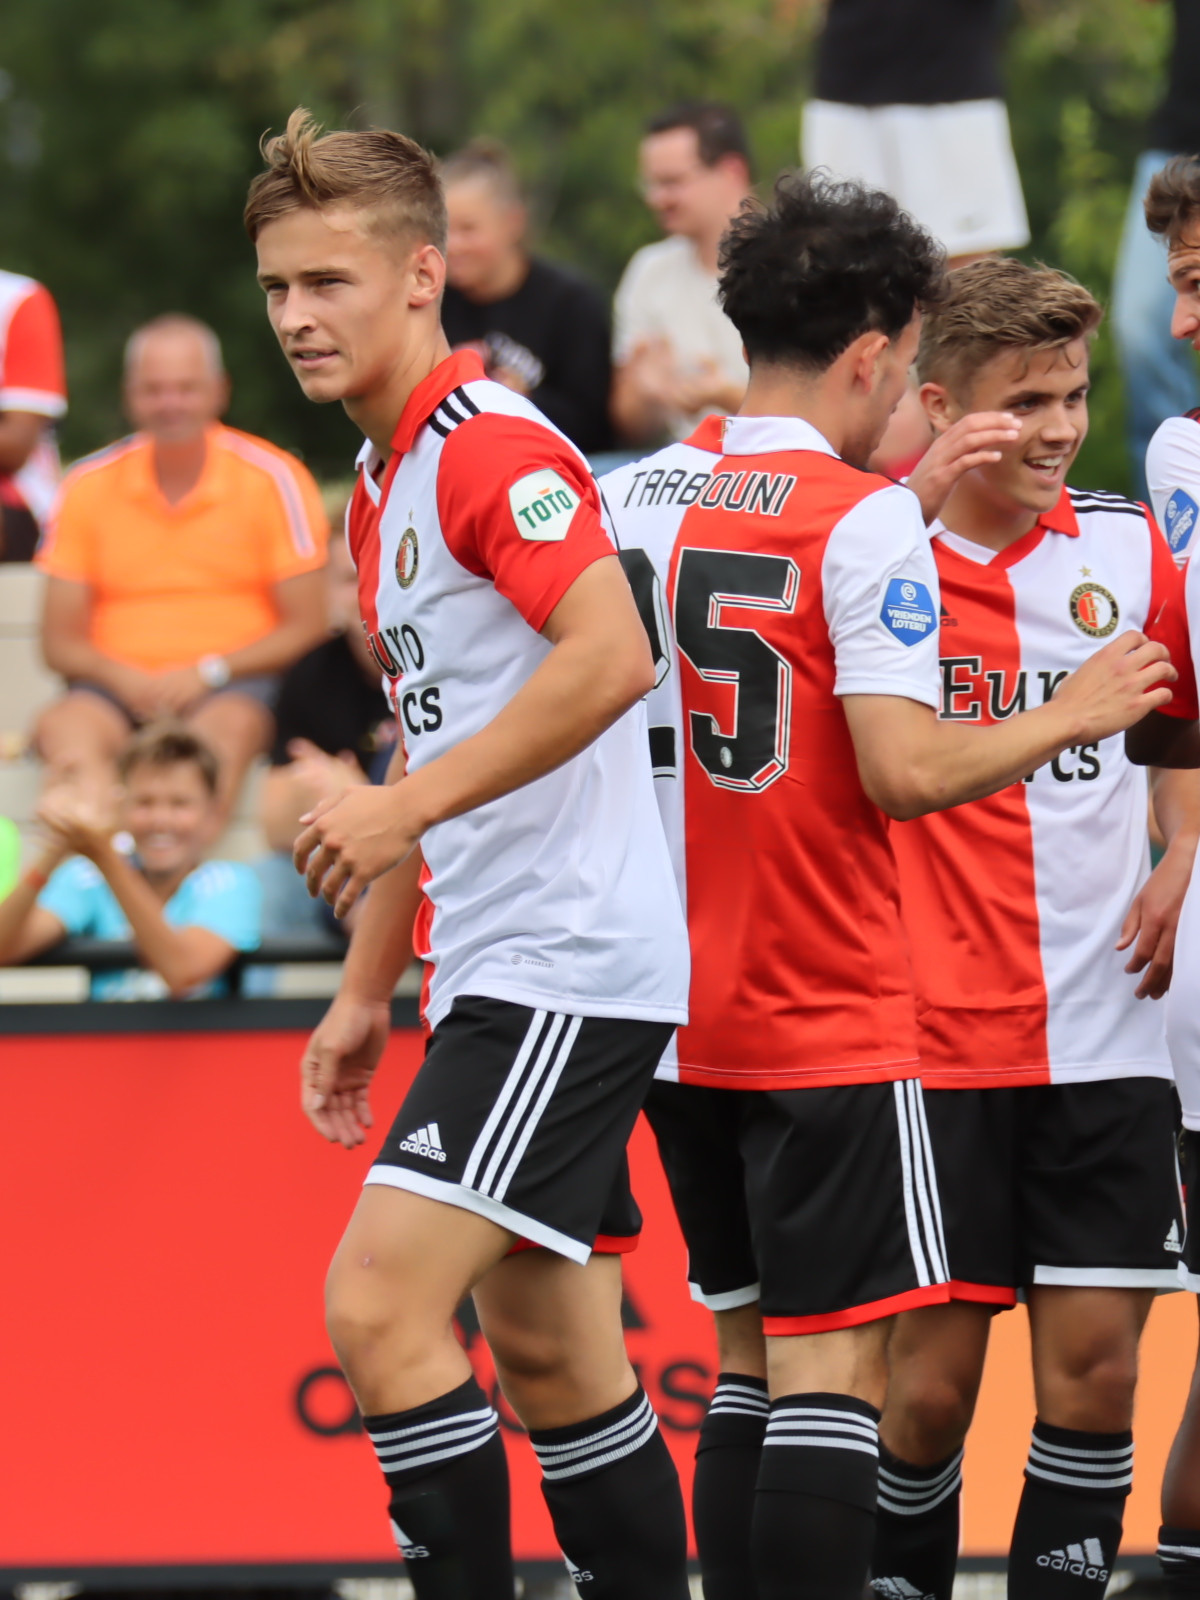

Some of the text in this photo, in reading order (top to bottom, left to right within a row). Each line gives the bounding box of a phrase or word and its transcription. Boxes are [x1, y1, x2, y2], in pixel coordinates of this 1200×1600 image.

[517, 489, 574, 529] TOTO
[623, 468, 798, 516] TAABOUNI
[887, 608, 932, 624] VRIENDEN
[362, 621, 425, 678] uro
[937, 656, 1070, 720] Eur
[396, 686, 443, 737] cs
[1024, 742, 1101, 783] cs
[399, 1139, 447, 1162] adidas
[1036, 1554, 1108, 1582] adidas
